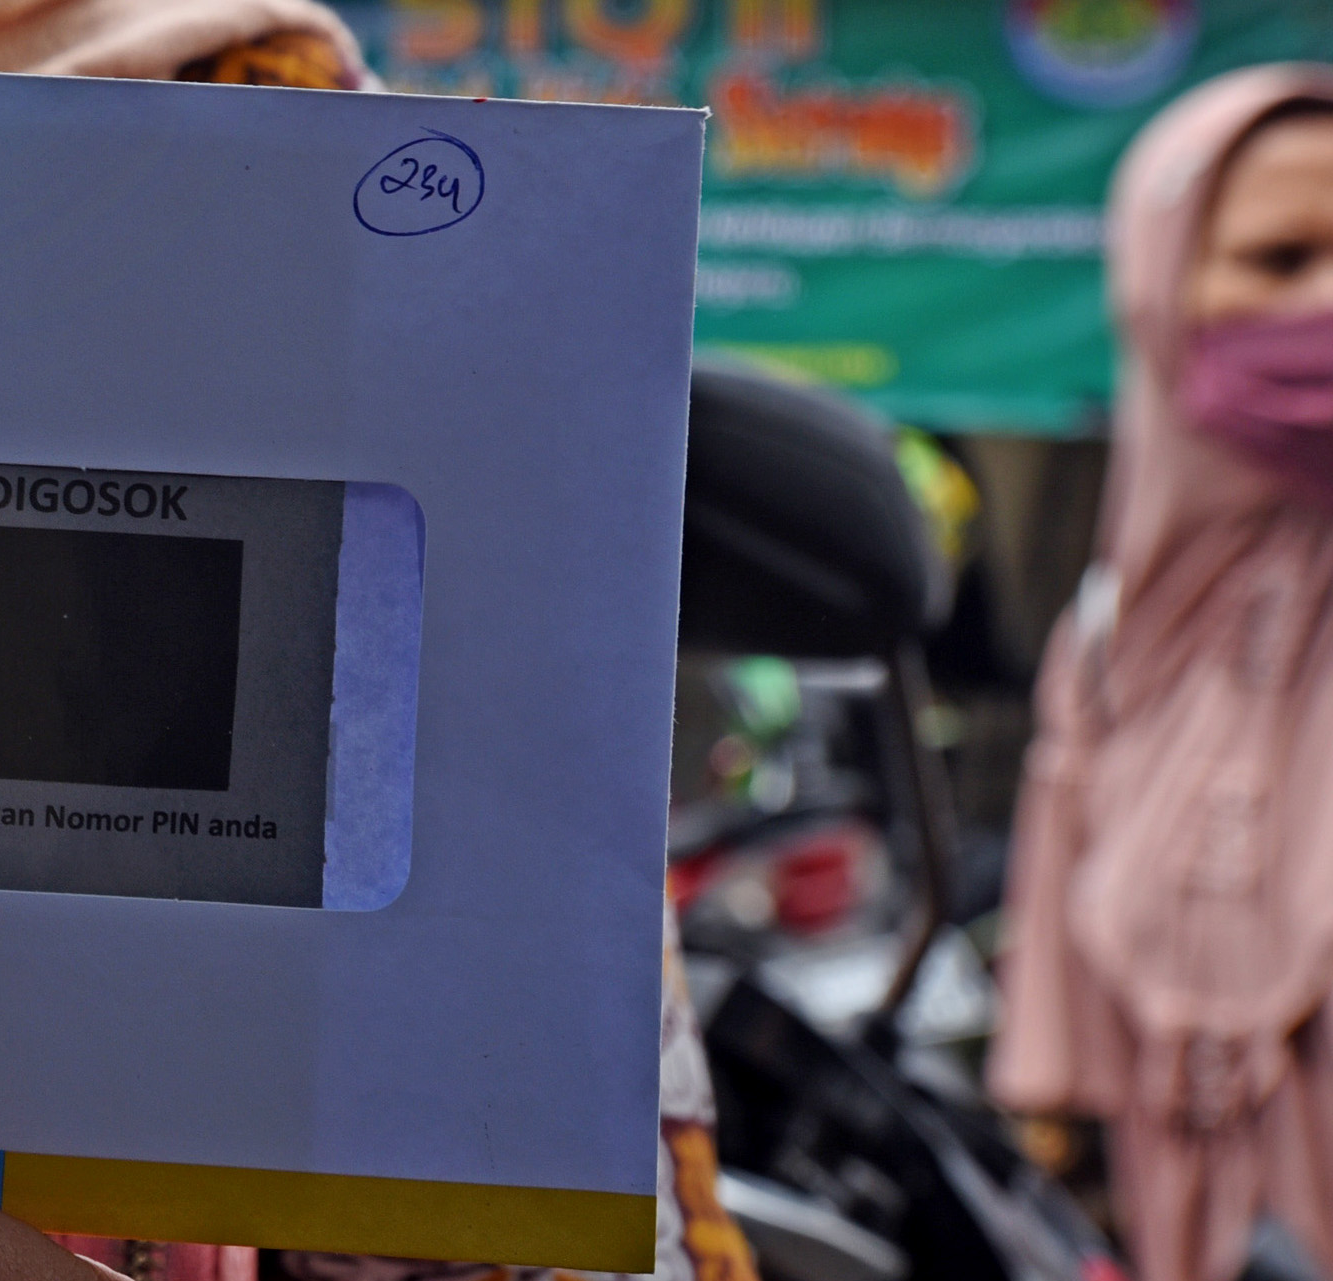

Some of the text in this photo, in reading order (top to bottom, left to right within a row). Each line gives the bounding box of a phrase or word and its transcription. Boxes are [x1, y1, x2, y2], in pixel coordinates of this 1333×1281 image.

[44, 804, 143, 834] Nomor
[151, 810, 200, 836] PIN
[208, 815, 278, 840] anda
